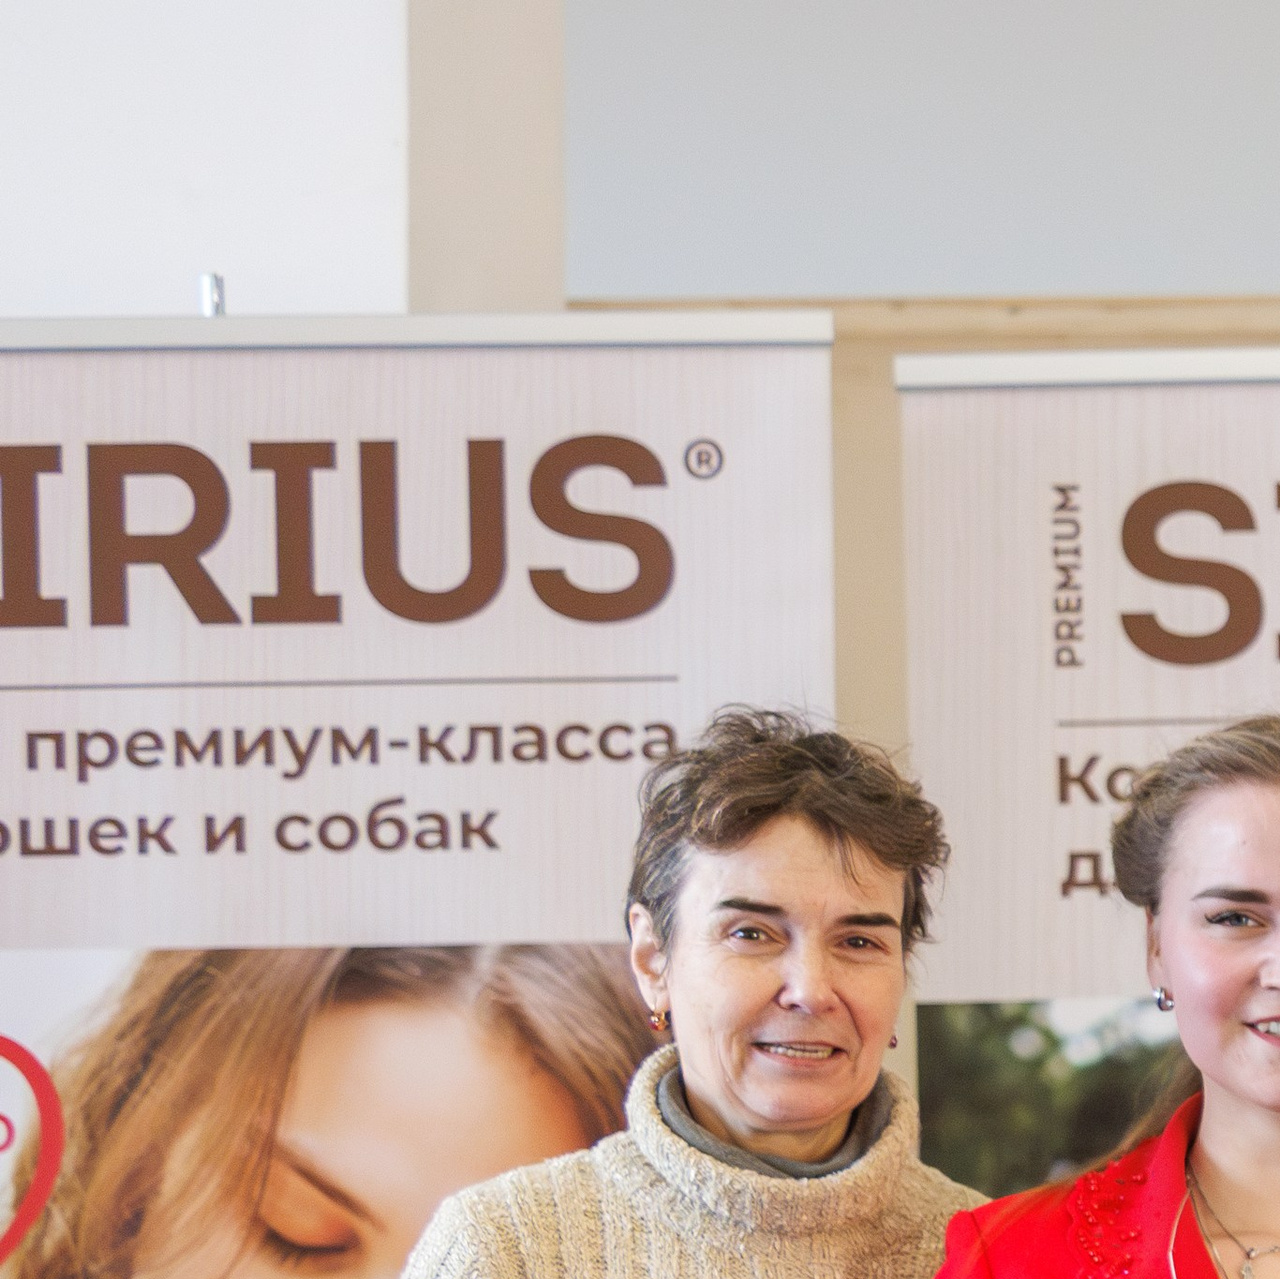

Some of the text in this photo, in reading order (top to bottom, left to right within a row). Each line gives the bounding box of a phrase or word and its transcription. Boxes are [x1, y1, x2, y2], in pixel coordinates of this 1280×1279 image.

[0, 434, 676, 628] IRIUS
[1053, 482, 1083, 669] PREMIUM
[24, 718, 677, 783] премиум-класса
[1057, 755, 1137, 805] Ко
[0, 797, 501, 857] шек и собак
